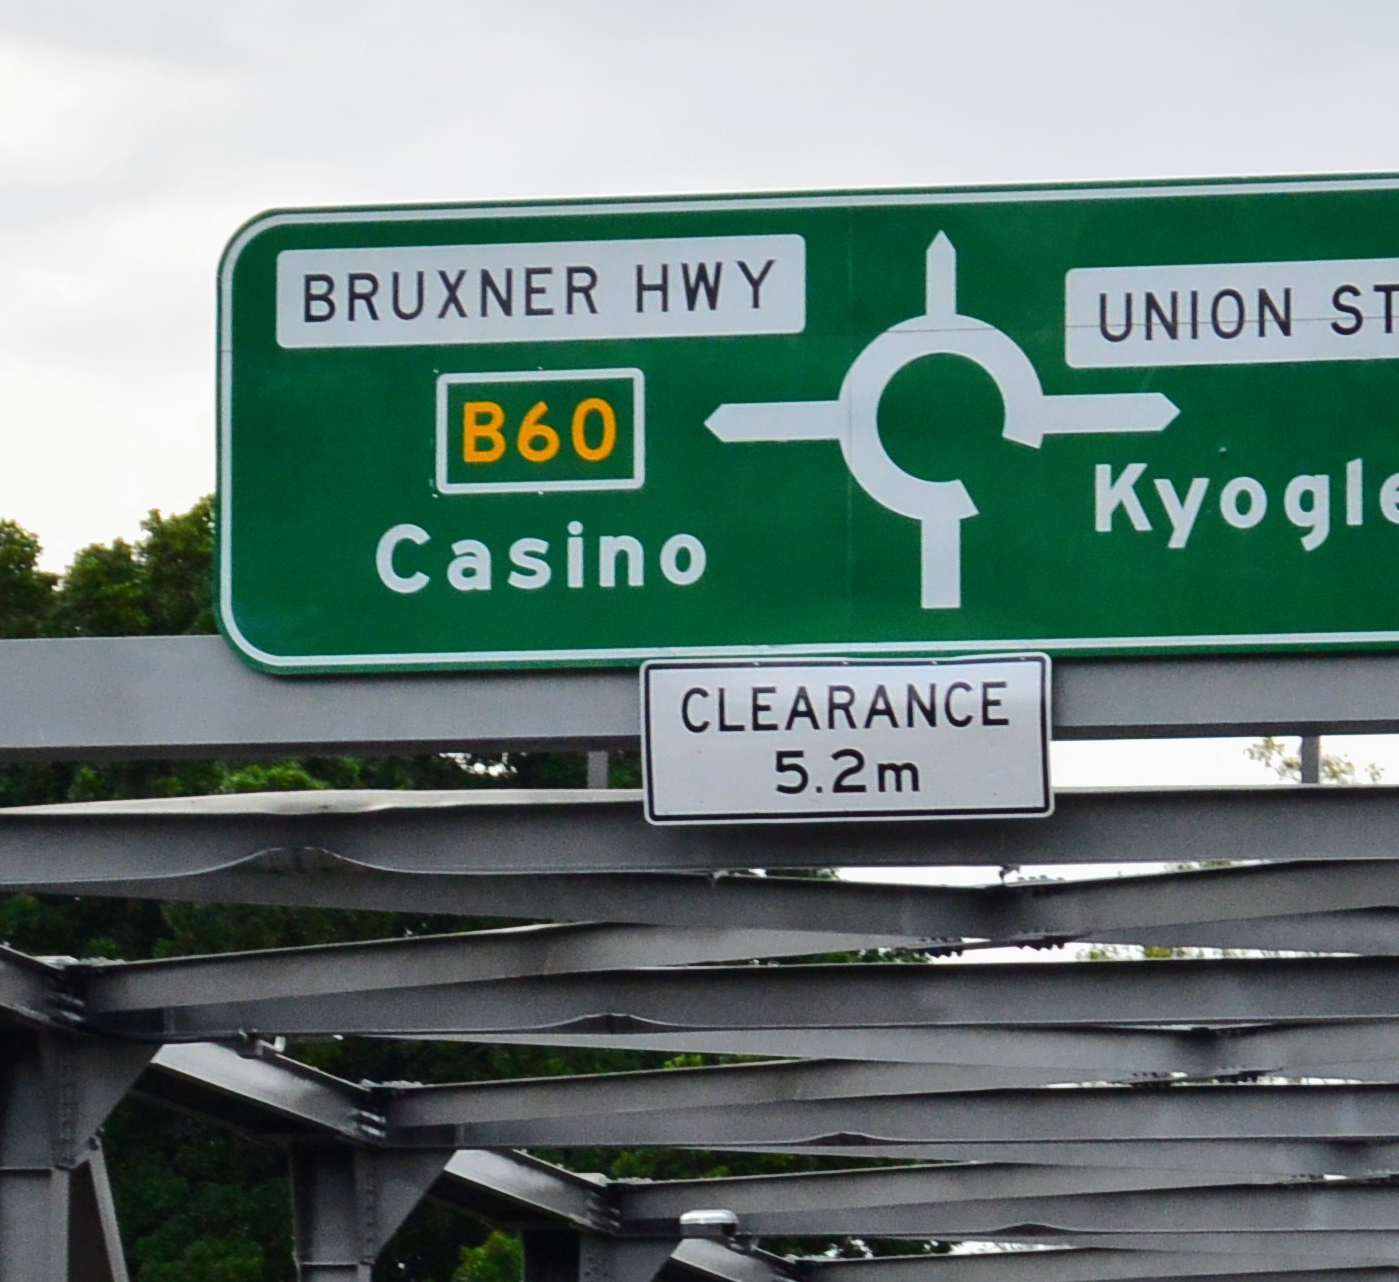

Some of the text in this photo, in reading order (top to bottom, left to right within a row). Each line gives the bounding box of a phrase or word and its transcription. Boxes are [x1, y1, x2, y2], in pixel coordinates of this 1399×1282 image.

[304, 259, 775, 323] BRUXNER HWY
[1099, 287, 1292, 343] UNION
[464, 398, 616, 463] B60
[375, 520, 707, 594] Casino
[681, 681, 1010, 734] CLEARANCE
[775, 748, 920, 795] 5.2m
